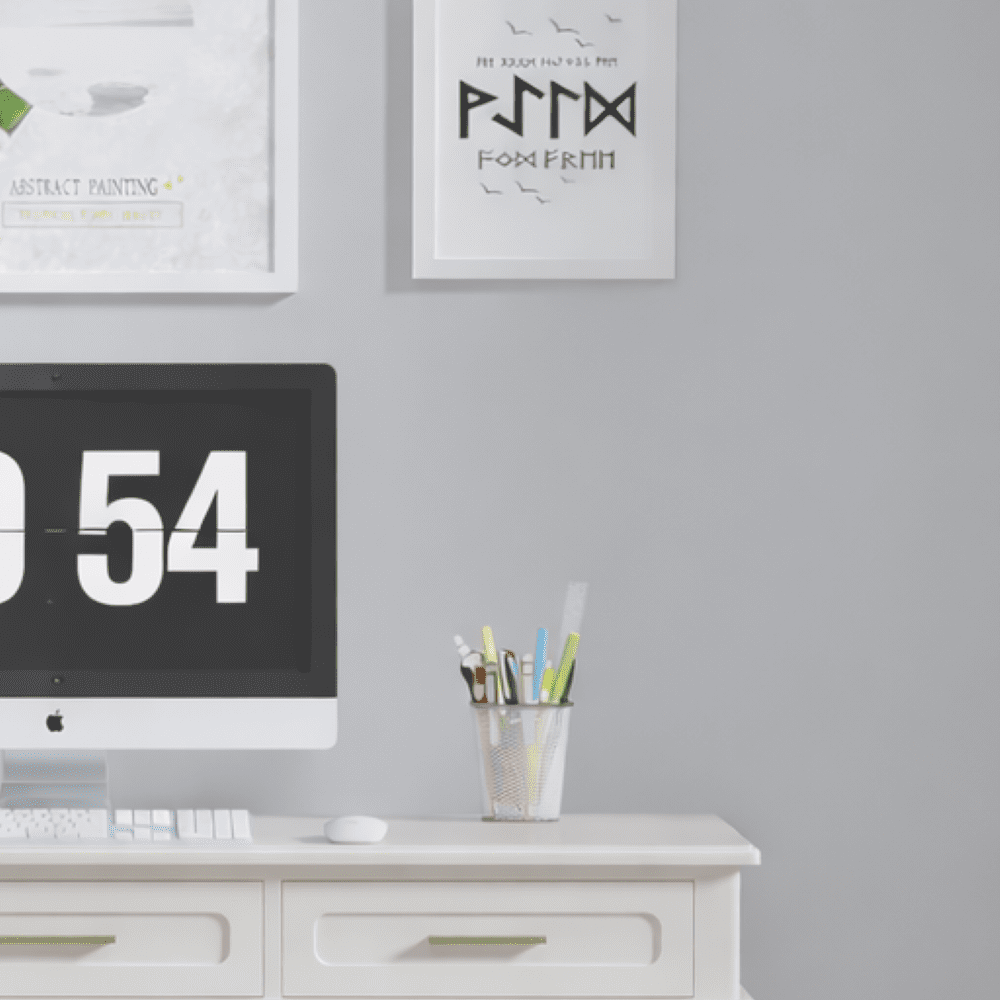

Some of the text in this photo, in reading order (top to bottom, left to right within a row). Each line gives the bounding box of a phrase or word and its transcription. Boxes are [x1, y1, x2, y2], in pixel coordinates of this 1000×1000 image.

[10, 177, 159, 196] ABSTRACT PAINTING
[76, 450, 259, 606] 54
